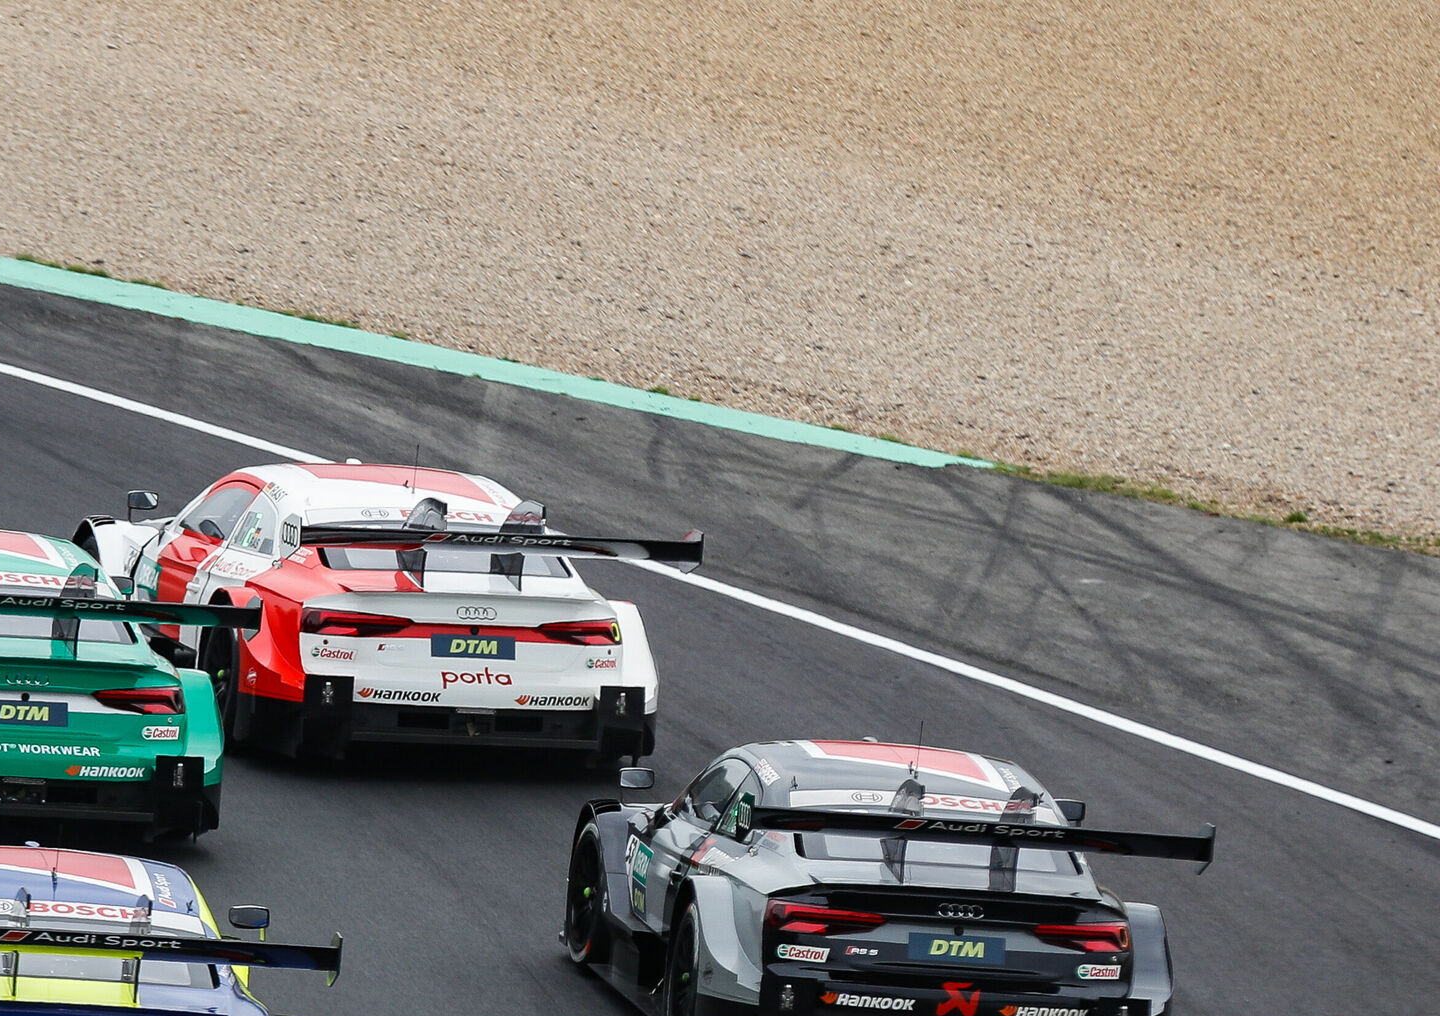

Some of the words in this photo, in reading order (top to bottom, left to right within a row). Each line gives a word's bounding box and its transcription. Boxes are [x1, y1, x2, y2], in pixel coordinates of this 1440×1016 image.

[400, 509, 494, 522] BSCH
[453, 534, 502, 544] Audi
[511, 536, 573, 547] Sport
[0, 596, 55, 608] Audi
[60, 599, 127, 611] Sport
[449, 639, 498, 655] DTM
[319, 648, 354, 661] Castrol
[594, 658, 617, 669] Castrol
[440, 667, 513, 690] porta
[152, 728, 178, 739] Castrol
[17, 743, 101, 757] WORKWEAR
[927, 821, 987, 833] Audi
[993, 824, 1066, 839] Sport
[33, 931, 97, 944] Audi
[103, 935, 182, 950] Sport
[787, 946, 826, 961] Castrol
[929, 939, 985, 958] DTM
[1089, 966, 1120, 978] Castrol
